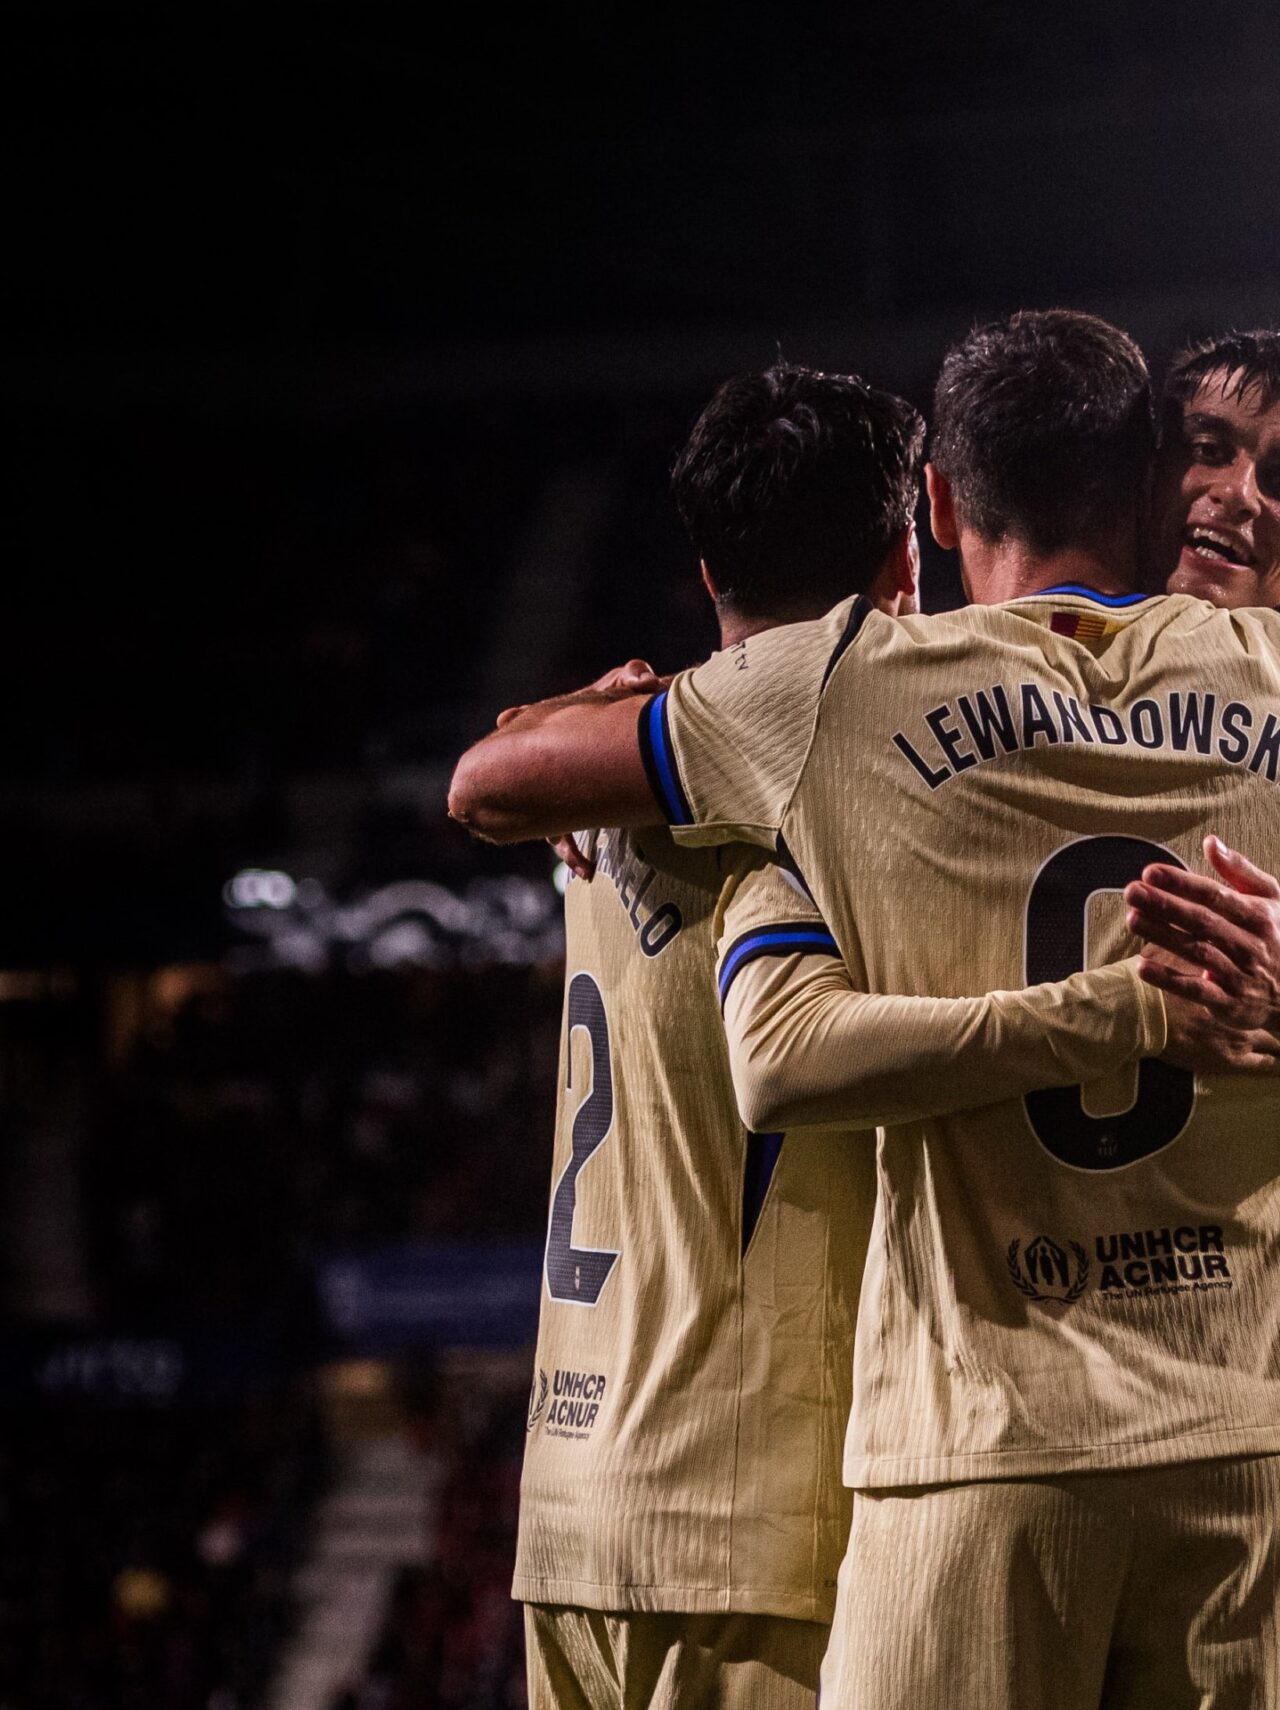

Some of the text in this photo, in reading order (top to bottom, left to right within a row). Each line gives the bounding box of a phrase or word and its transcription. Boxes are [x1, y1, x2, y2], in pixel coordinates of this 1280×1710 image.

[547, 972, 622, 1305] 2
[1095, 1226, 1225, 1263] UNHCR
[1100, 1255, 1232, 1290] ACNUR
[1102, 1281, 1232, 1300] The UN Refugee Agency
[553, 1369, 606, 1401] UNHCR
[546, 1399, 599, 1428] ACNUR
